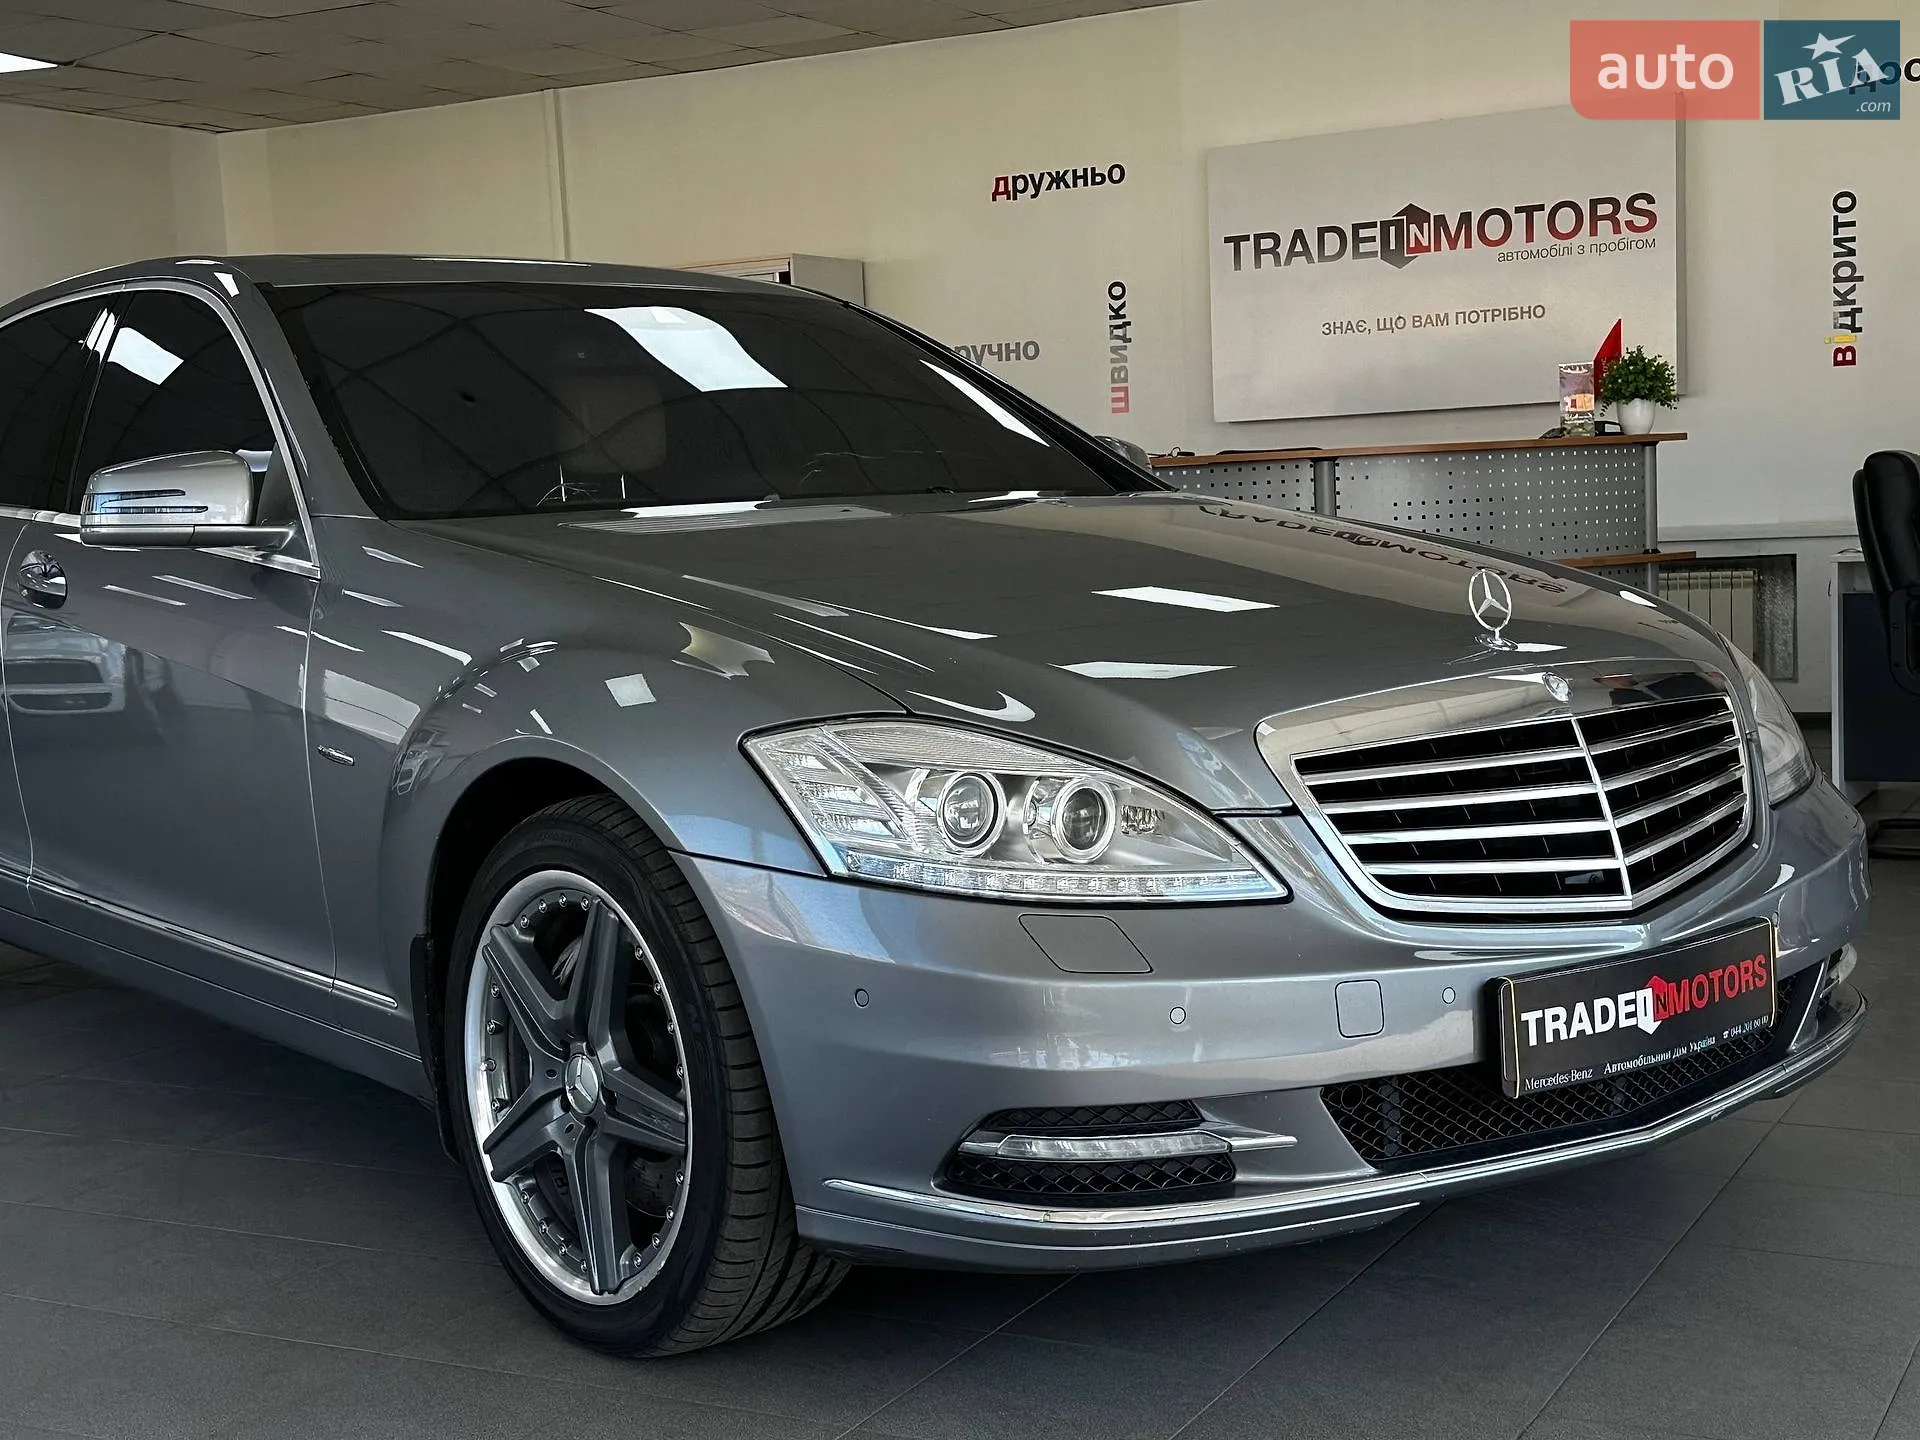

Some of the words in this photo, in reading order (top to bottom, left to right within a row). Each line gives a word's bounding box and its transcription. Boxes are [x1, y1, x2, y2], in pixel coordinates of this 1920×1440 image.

[991, 163, 1126, 201] дружньо
[1497, 239, 1574, 263] автомобілі
[1577, 243, 1586, 256] з
[1590, 236, 1656, 258] пробігом
[1824, 191, 1864, 367] відкрито
[1321, 319, 1372, 336] ЗНАЄ,
[1376, 316, 1407, 334] ЩО
[1412, 312, 1450, 329] ВАМ
[1455, 304, 1547, 326] ПОТРІБНО
[954, 341, 1040, 366] ручно
[1107, 281, 1132, 414] швидко
[1525, 1068, 1593, 1091] Mercedes-Benz
